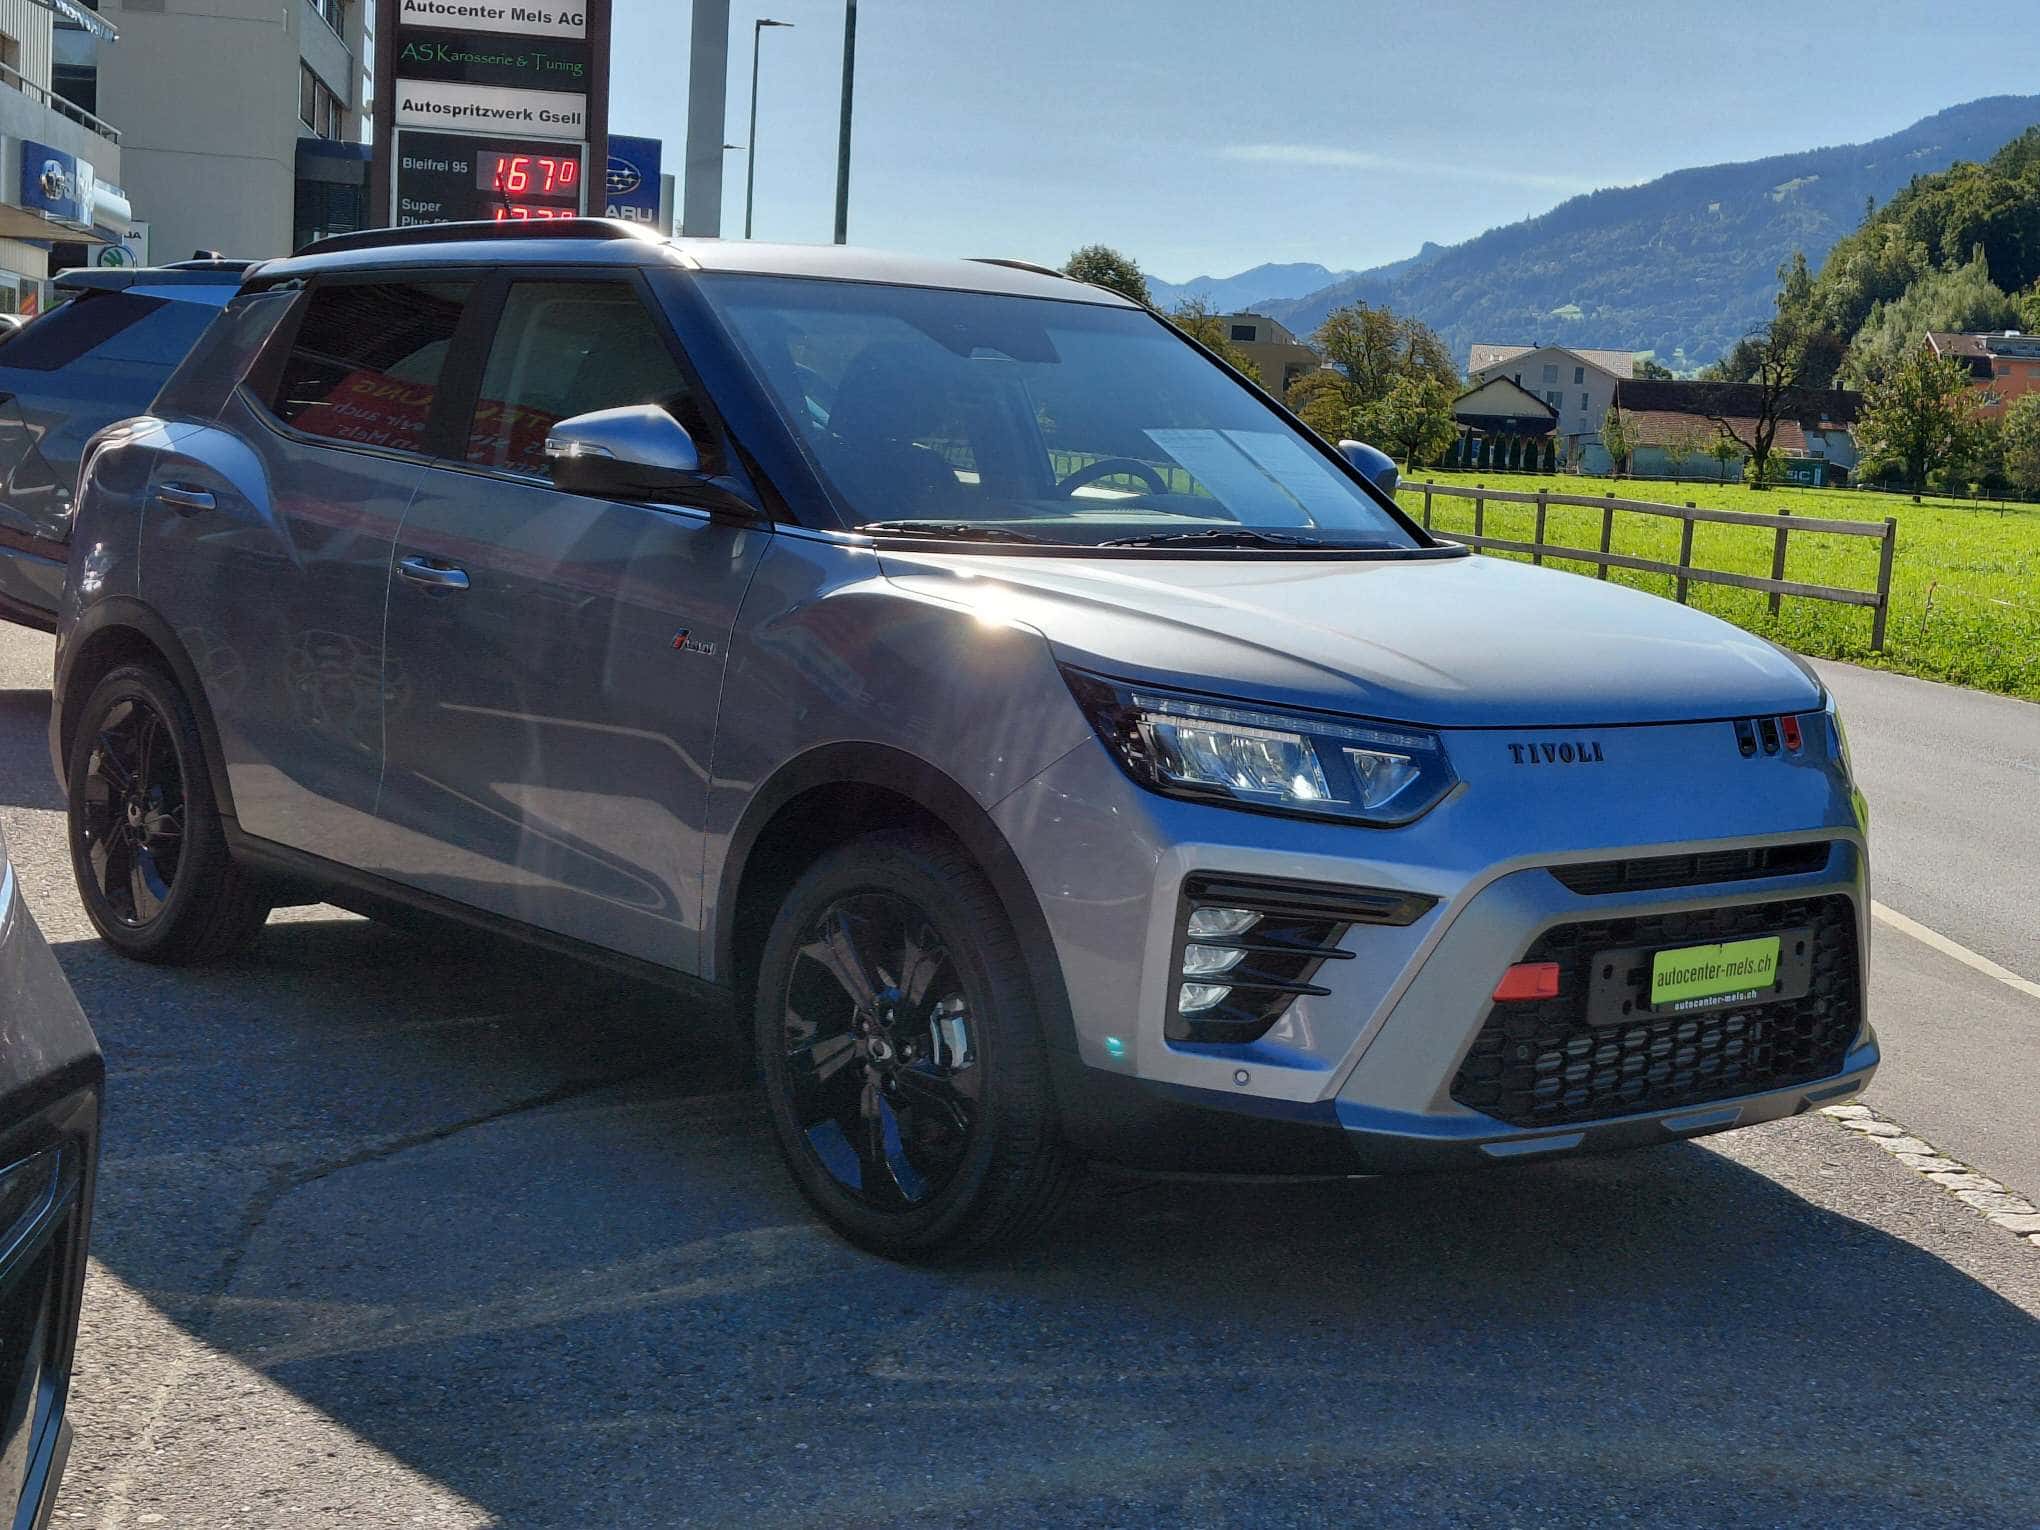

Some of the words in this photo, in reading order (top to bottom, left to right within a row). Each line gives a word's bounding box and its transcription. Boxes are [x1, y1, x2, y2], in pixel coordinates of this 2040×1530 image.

[403, 0, 506, 19] Autocenter
[511, 7, 552, 23] Mels
[558, 12, 584, 26] AG
[516, 55, 529, 67] &
[530, 52, 584, 77] Tuning
[402, 98, 533, 121] Autospritzwerk
[539, 109, 581, 125] Gsell
[402, 157, 449, 172] Bleifrei
[452, 161, 468, 173] 95
[402, 198, 442, 214] Super
[605, 204, 653, 222] ARU
[1507, 742, 1604, 764] TIVOLI
[1657, 953, 1772, 988] autocenter-mels.ch
[1674, 989, 1757, 1011] autocenter-mels.ch
